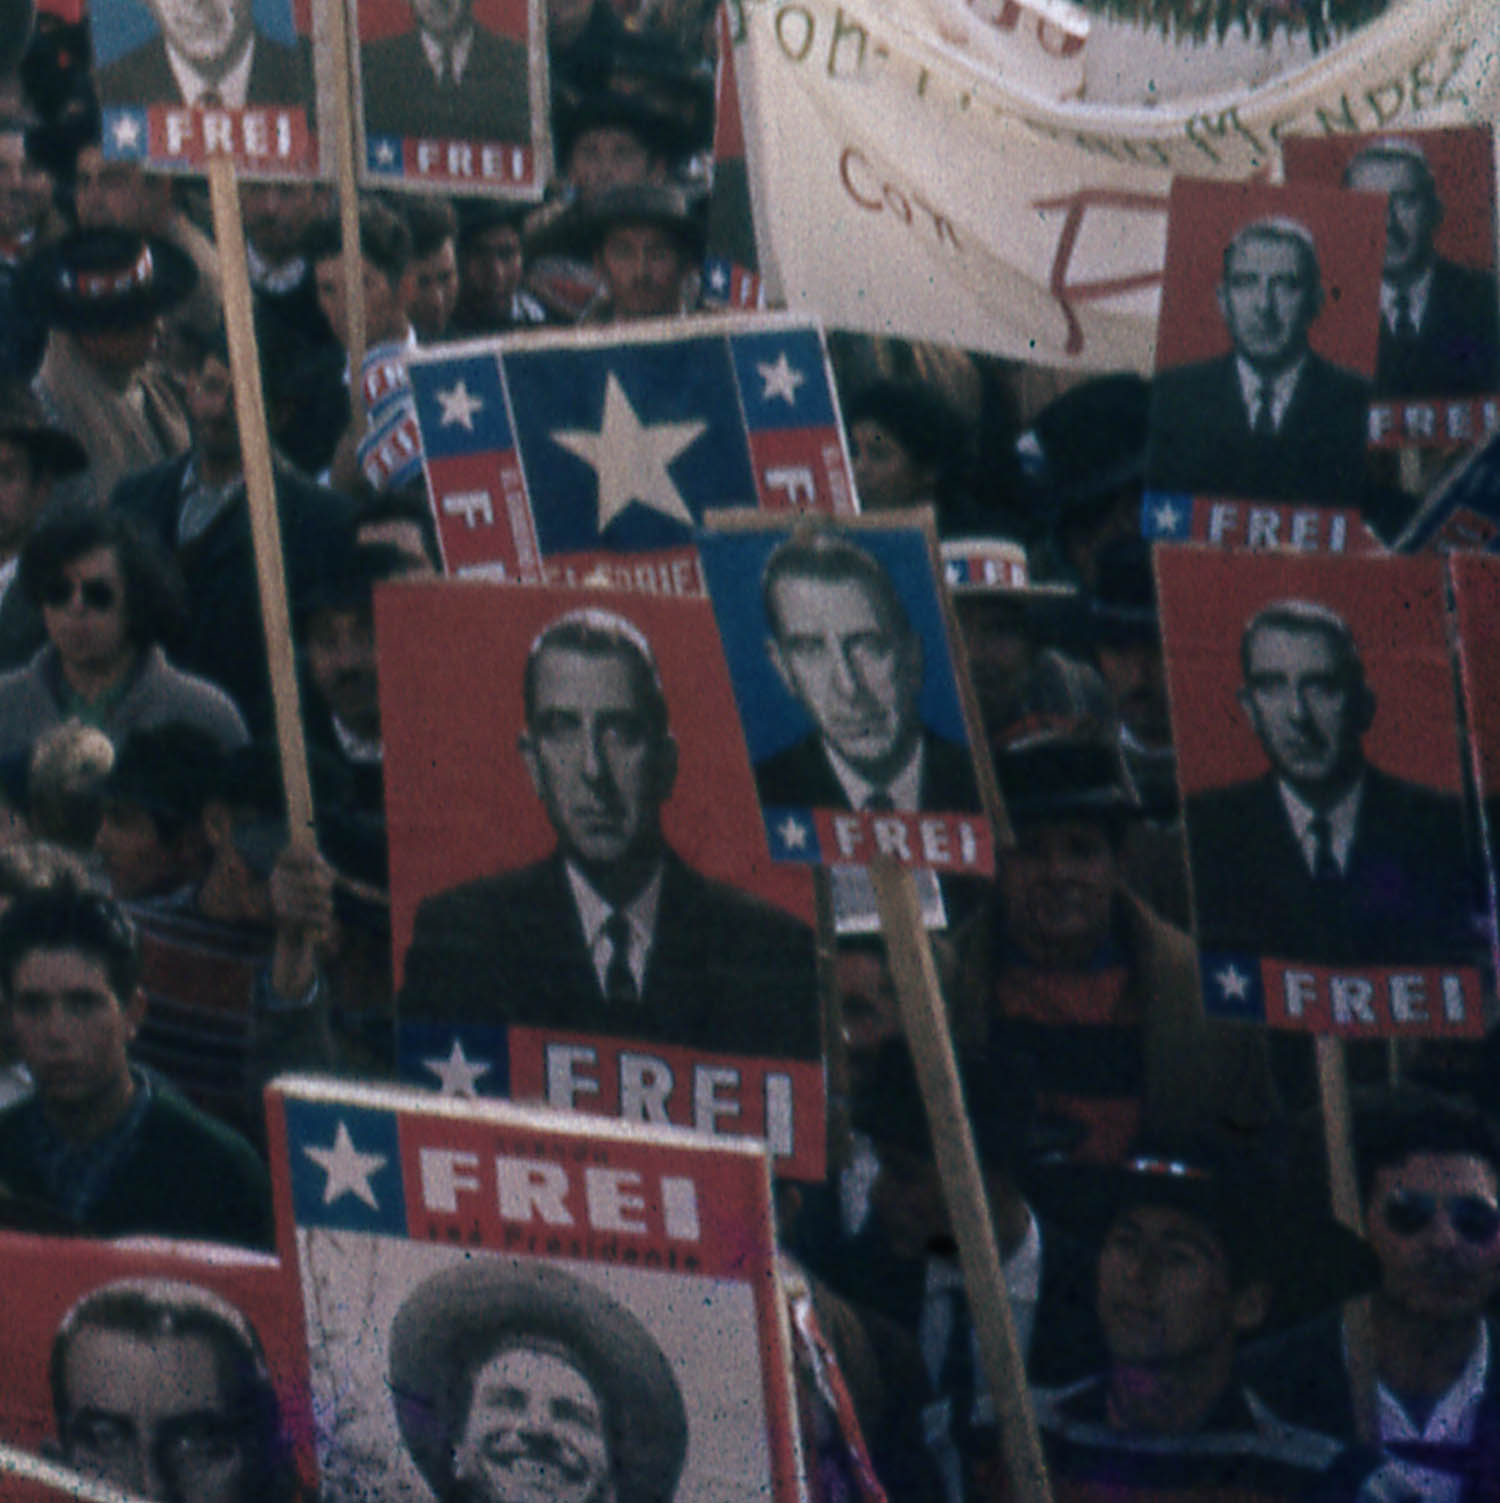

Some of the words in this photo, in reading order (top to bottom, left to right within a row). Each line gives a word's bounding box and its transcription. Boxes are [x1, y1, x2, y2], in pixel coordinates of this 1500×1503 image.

[167, 110, 294, 156] FREI
[416, 140, 525, 180] FREI
[1366, 397, 1499, 446] FREI
[1209, 502, 1349, 552] FREI
[834, 815, 978, 864] FREI
[1283, 967, 1467, 1026] FREI
[542, 1040, 796, 1160] FREI
[418, 1146, 702, 1242] FREI
